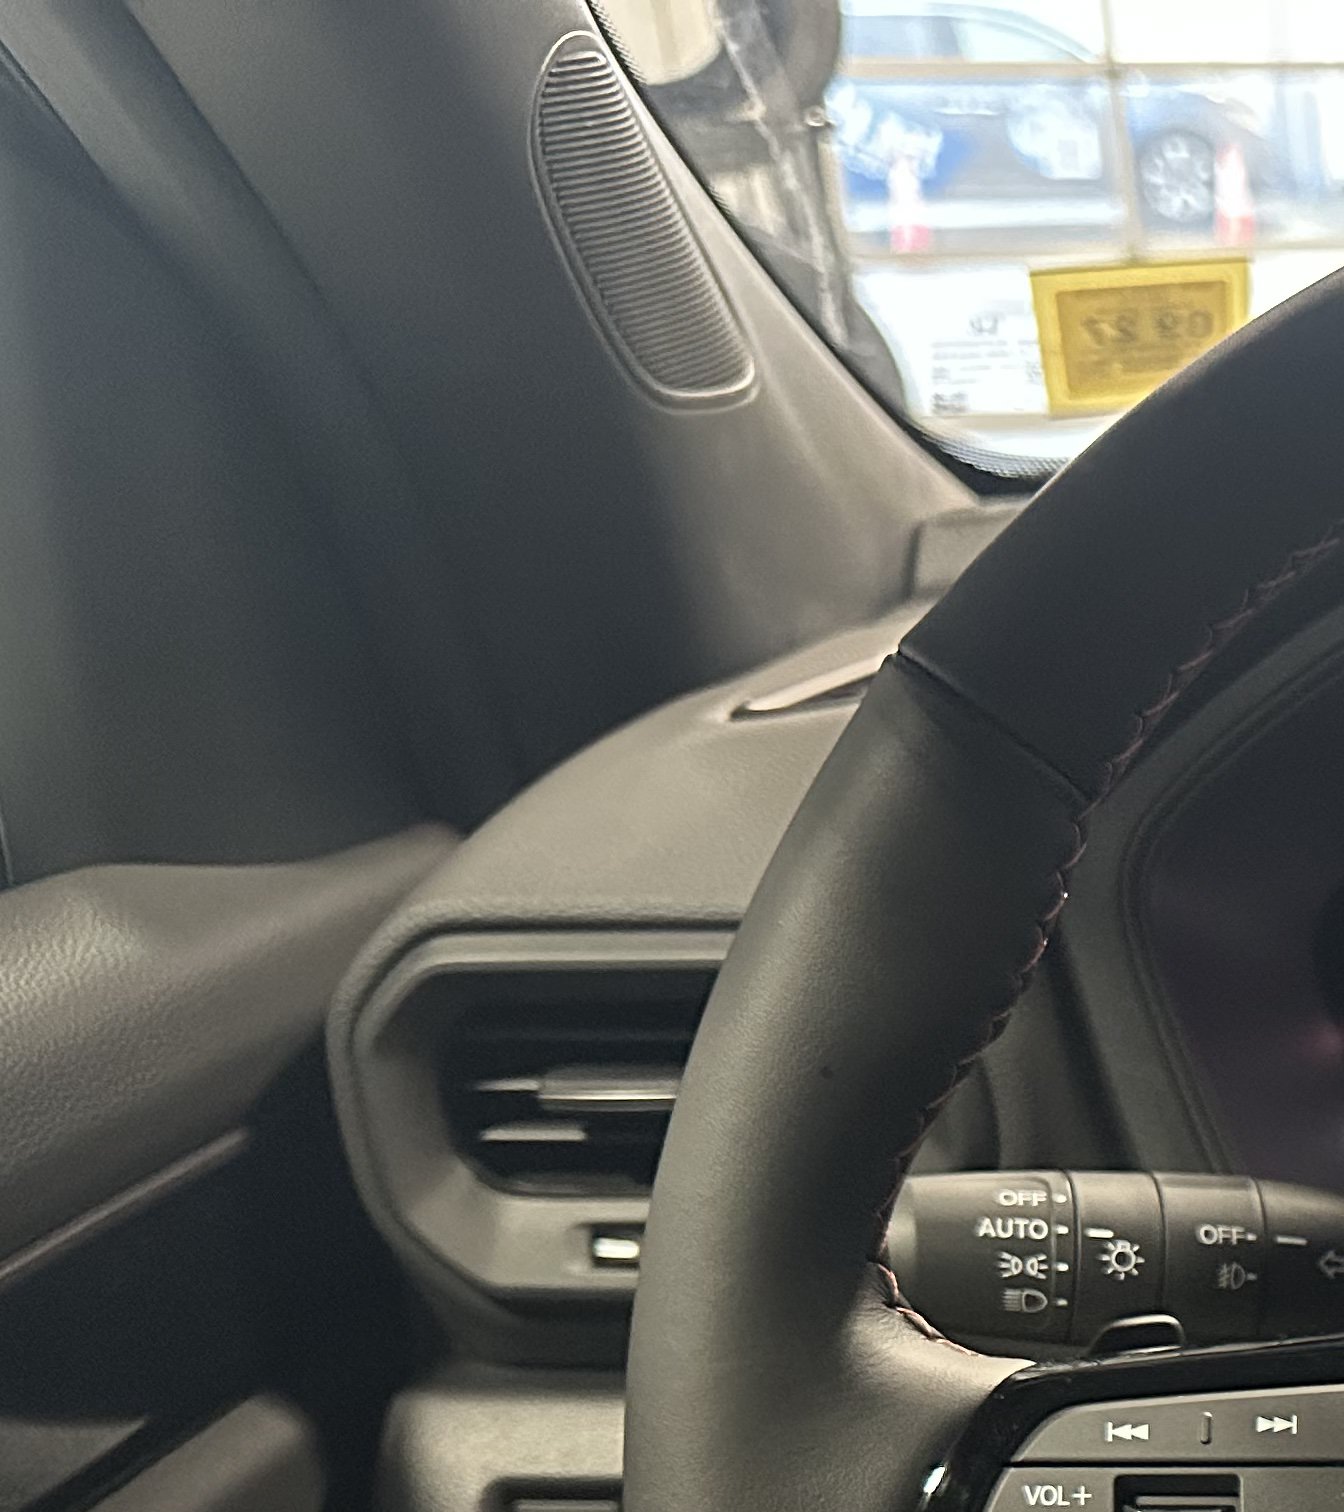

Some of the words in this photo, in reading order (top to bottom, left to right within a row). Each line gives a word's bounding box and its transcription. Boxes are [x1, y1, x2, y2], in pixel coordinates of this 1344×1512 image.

[999, 1190, 1048, 1206] OFF
[976, 1218, 1049, 1240] AUTO
[1198, 1225, 1245, 1246] OFF
[1023, 1485, 1093, 1507] VOL+
